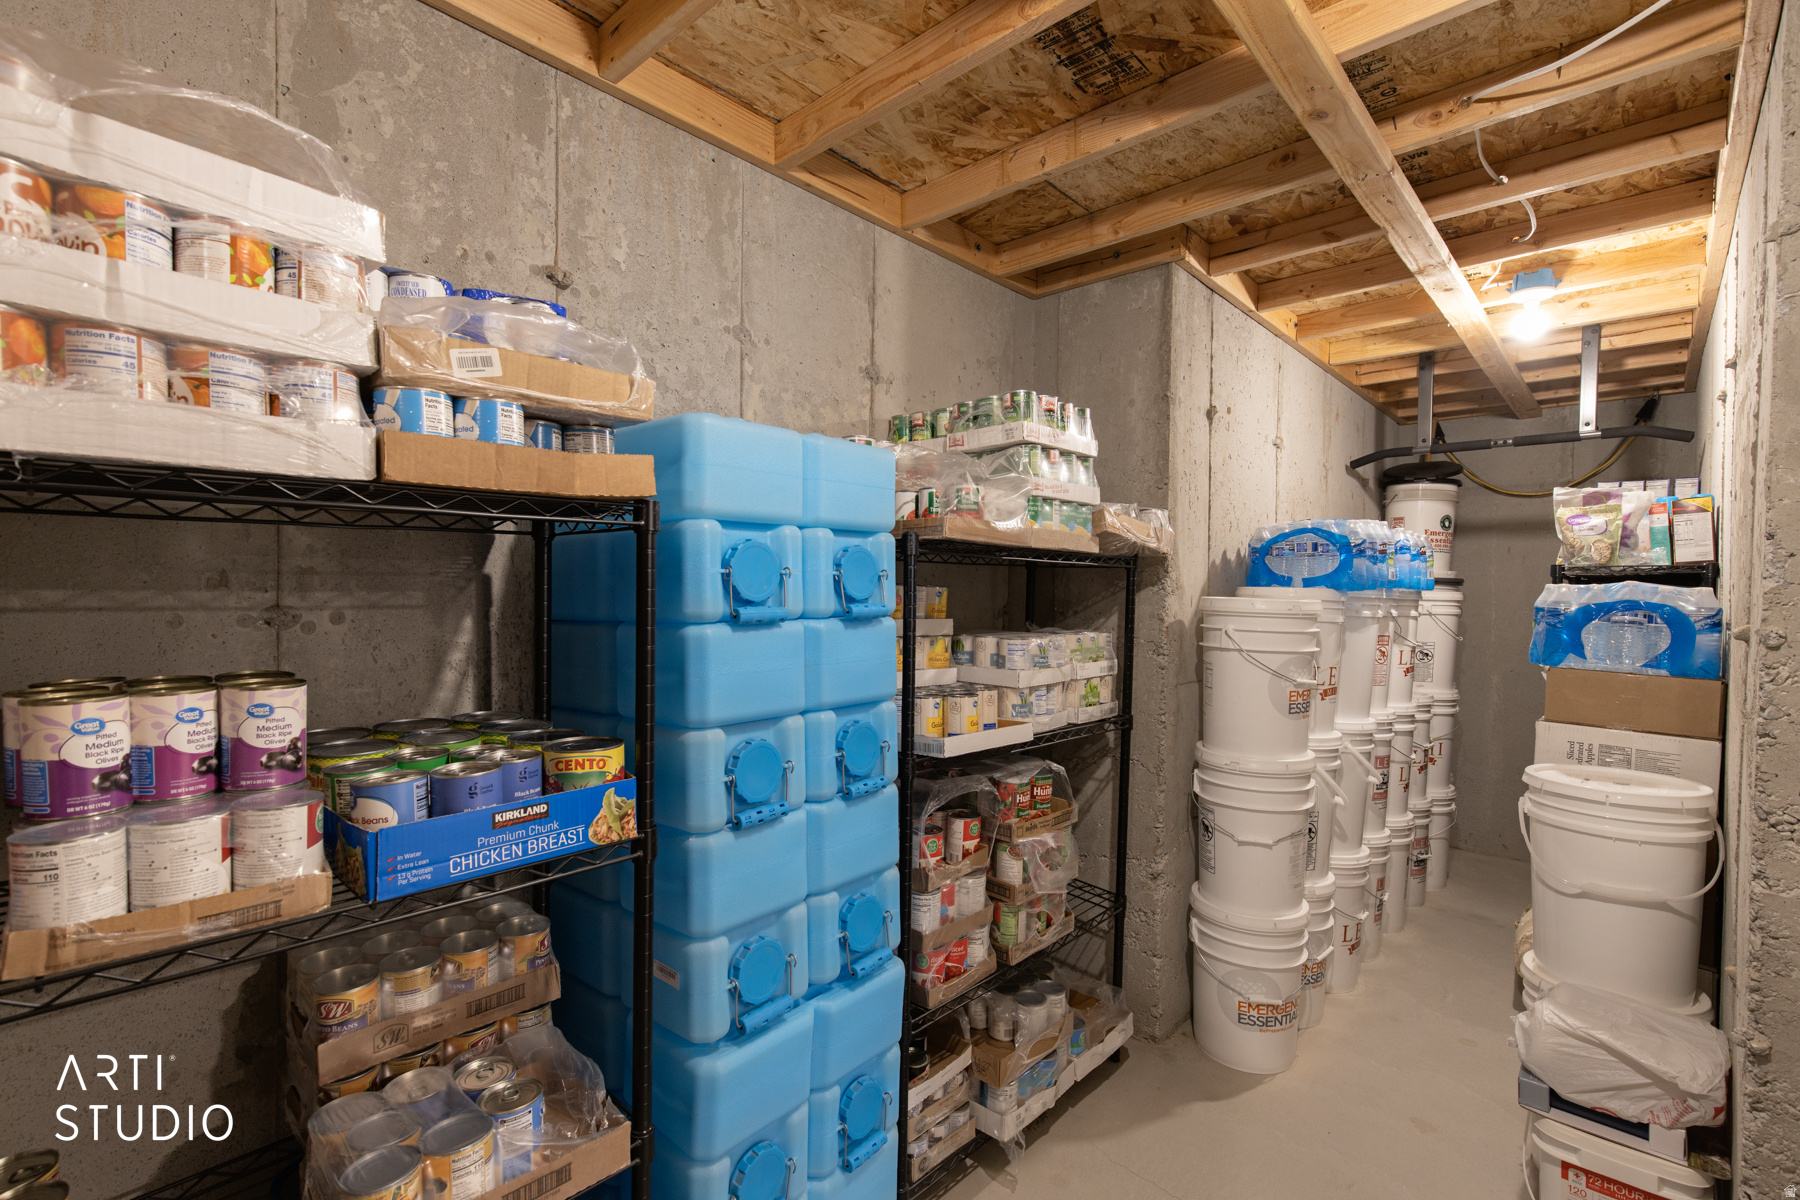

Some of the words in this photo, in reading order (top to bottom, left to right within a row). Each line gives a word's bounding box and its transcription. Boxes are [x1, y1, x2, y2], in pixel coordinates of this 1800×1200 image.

[1062, 56, 1083, 69] DOWN
[1401, 150, 1428, 163] MAY
[287, 271, 297, 279] 45
[395, 280, 420, 288] SWEETENED
[391, 287, 427, 298] CONDENSED
[65, 329, 106, 339] Nutrition
[108, 332, 136, 345] Facts
[210, 352, 247, 363] Nutrition
[67, 357, 98, 365] Calories
[122, 361, 136, 370] 45
[178, 710, 200, 719] Great
[249, 706, 269, 714] Great
[74, 720, 100, 730] Great
[195, 720, 212, 728] Pitted
[265, 716, 285, 724] Pitted
[256, 723, 293, 732] Medium
[96, 732, 117, 740] Pitted
[256, 731, 276, 739] Black
[278, 730, 293, 738] Ripe
[85, 738, 124, 751] Medium
[187, 737, 205, 745] Black
[195, 742, 213, 750] Olives
[264, 738, 286, 746] Olives
[85, 751, 108, 759] Black
[110, 746, 125, 756] Ripe
[1566, 740, 1575, 760] Sliced
[1585, 743, 1595, 766] Apples
[95, 755, 119, 765] Olives
[555, 758, 607, 772] CENTO
[514, 790, 529, 798] Black
[95, 801, 111, 809] (170g)
[495, 803, 548, 823] KIRKLAND
[361, 816, 389, 825] Beans
[495, 813, 548, 829] Signature
[477, 828, 526, 848] Premium
[528, 820, 559, 836] Chunk
[35, 850, 58, 858] Facts
[404, 851, 422, 860] Water
[450, 843, 523, 874] CHICKEN
[528, 827, 585, 855] BREAST
[397, 862, 414, 870] Extra
[415, 858, 429, 866] Lean
[412, 866, 434, 876] Protein
[43, 873, 59, 881] 110
[409, 872, 431, 884] Serving
[332, 1021, 358, 1032] BEANS
[451, 1152, 471, 1164] Nutrition
[452, 1170, 472, 1180] Calories
[1568, 1184, 1588, 1198] 120
[1588, 1174, 1602, 1187] 72
[1604, 1181, 1645, 1200] HOUR
